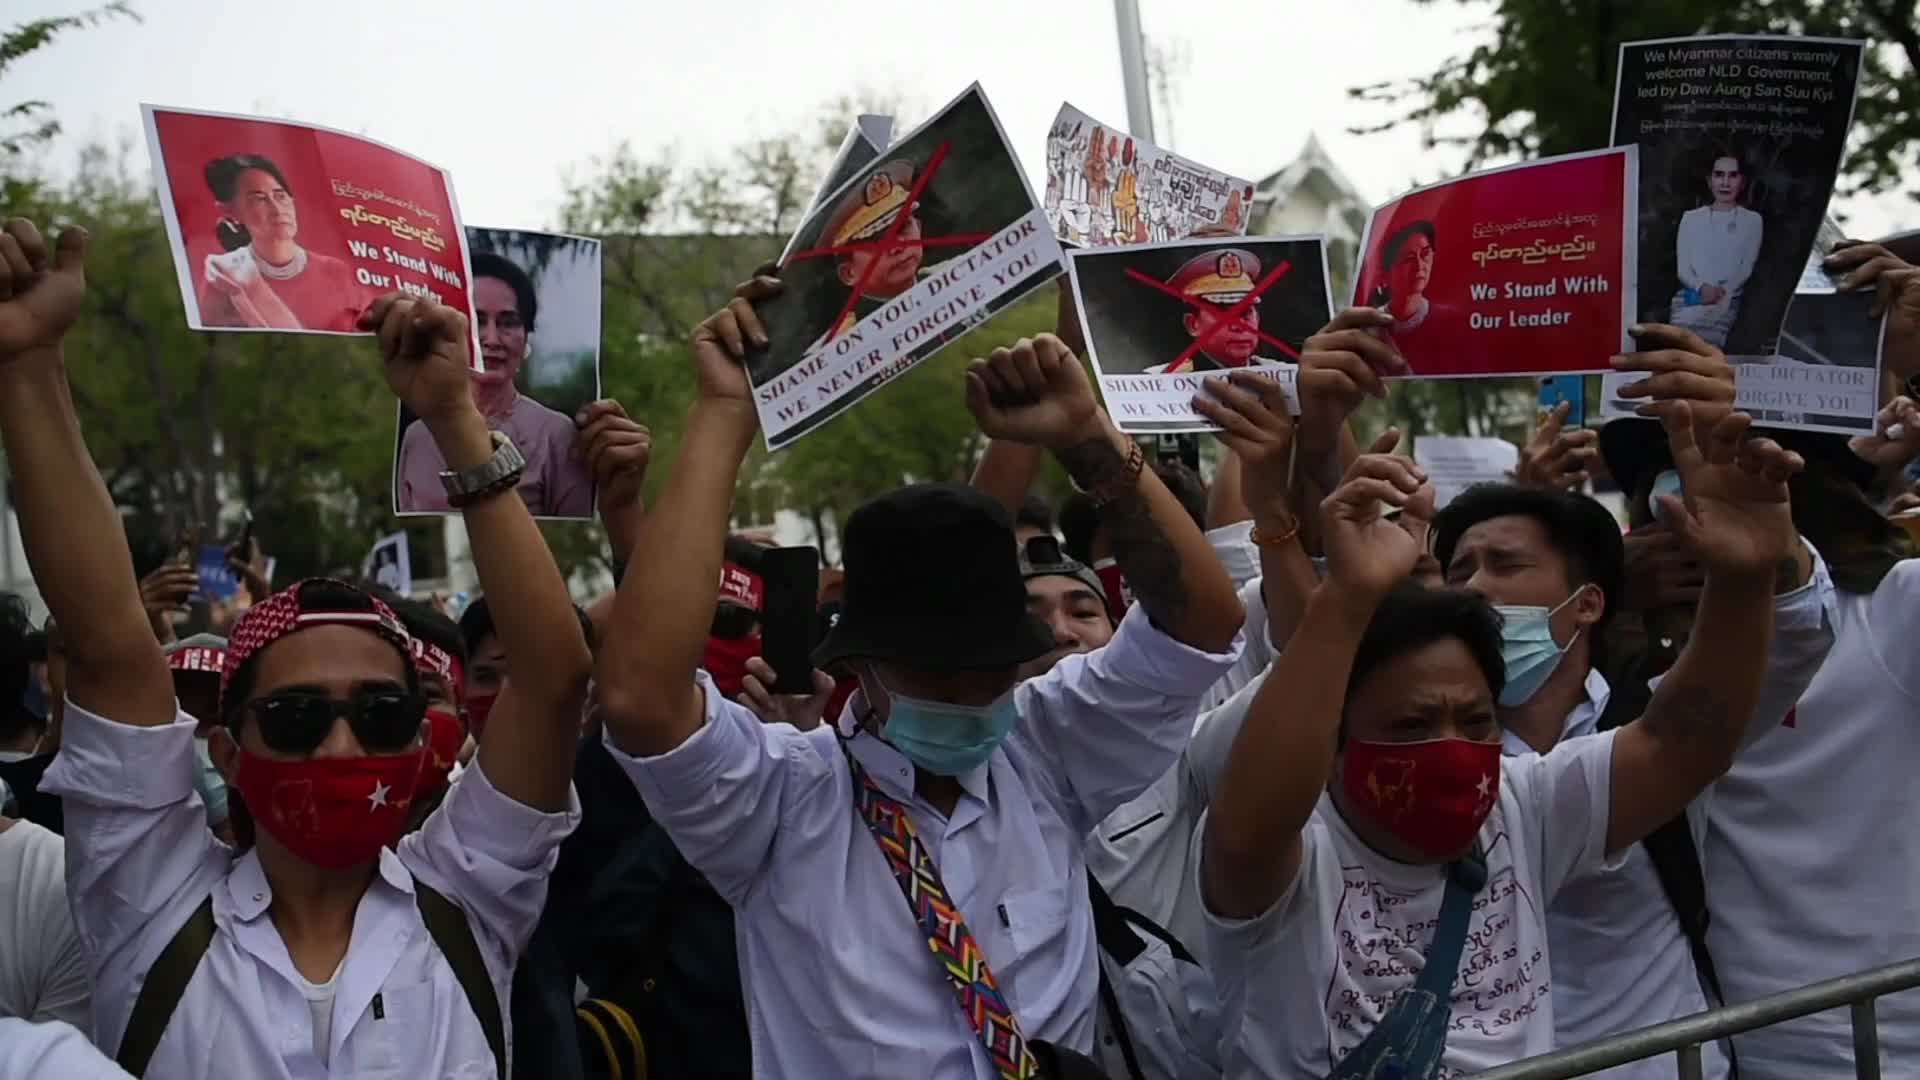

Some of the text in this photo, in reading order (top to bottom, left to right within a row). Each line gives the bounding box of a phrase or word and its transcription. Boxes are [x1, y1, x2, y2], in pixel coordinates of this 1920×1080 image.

[1643, 48, 1841, 67] We Myanmar citizens warmly
[1645, 66, 1706, 81] welcome
[1709, 64, 1741, 78] NLD
[1638, 83, 1834, 103] led by Daw Aung San Suu Kyi
[347, 239, 462, 288] We Stand With
[356, 267, 390, 287] Our
[1470, 274, 1609, 301] We Stand With
[759, 353, 830, 405] SHAME
[834, 327, 865, 356] ON
[927, 219, 1037, 296] DICTATOR
[1470, 308, 1572, 329] Our Leader
[776, 395, 811, 423] WE
[817, 349, 884, 396] NEVER
[891, 284, 988, 352] FORGIVE
[992, 248, 1040, 286] YOU
[1104, 377, 1167, 393] SHAME
[1173, 377, 1199, 392] ON
[1770, 365, 1865, 386] DICTATOR
[1121, 402, 1193, 416] WE NEV
[1737, 392, 1857, 410] ORGIVE YOU
